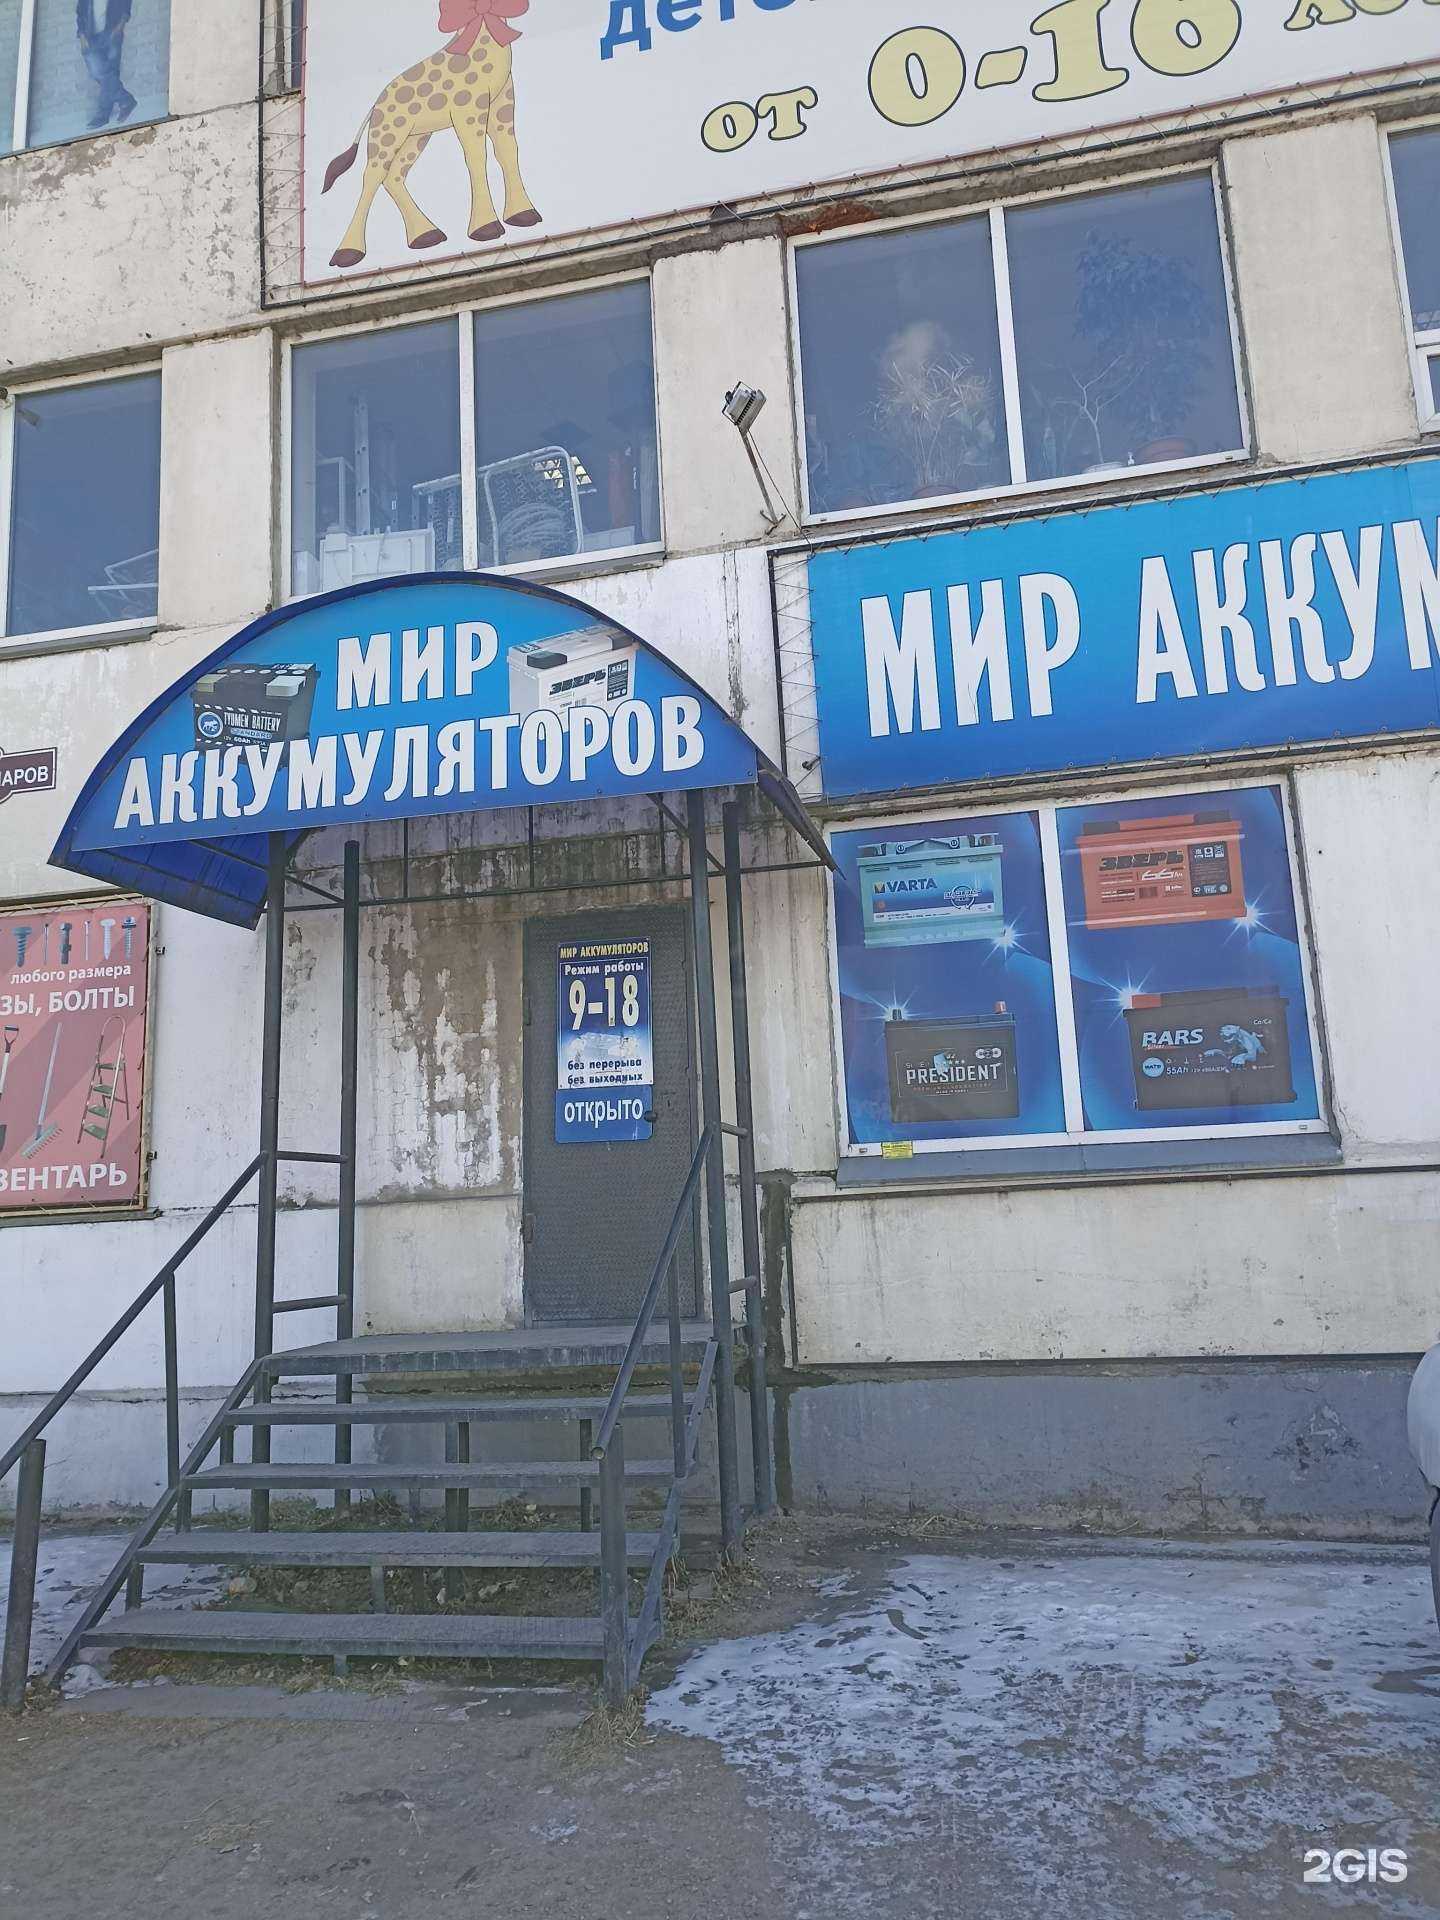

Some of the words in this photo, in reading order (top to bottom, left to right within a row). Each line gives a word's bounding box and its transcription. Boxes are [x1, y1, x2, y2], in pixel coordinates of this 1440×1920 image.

[700, 86, 818, 153] от
[860, 571, 1082, 738] МИР
[1135, 516, 1440, 704] АККУМ
[336, 621, 499, 711] МИР
[224, 711, 249, 728] TYUMEN
[251, 714, 281, 732] BATTERY
[113, 695, 706, 830] АККУМУЛЯТОРОВ
[0, 765, 49, 786] АРОВ
[886, 877, 938, 893] VARTA
[560, 947, 577, 959] МИР
[580, 941, 649, 957] АККУМУЛЯТОРОВ
[10, 968, 66, 985] любого
[68, 964, 132, 984] размера
[564, 964, 600, 976] Режим
[604, 960, 644, 976] работы
[48, 985, 135, 1013] БОЛТЫ
[569, 974, 640, 1031] 9-18
[1142, 1028, 1204, 1047] BARS
[567, 1059, 585, 1071] без
[589, 1057, 642, 1072] перерыва
[906, 1062, 1003, 1086] PRESIDENT
[567, 1073, 585, 1085] без
[589, 1072, 643, 1085] выходных
